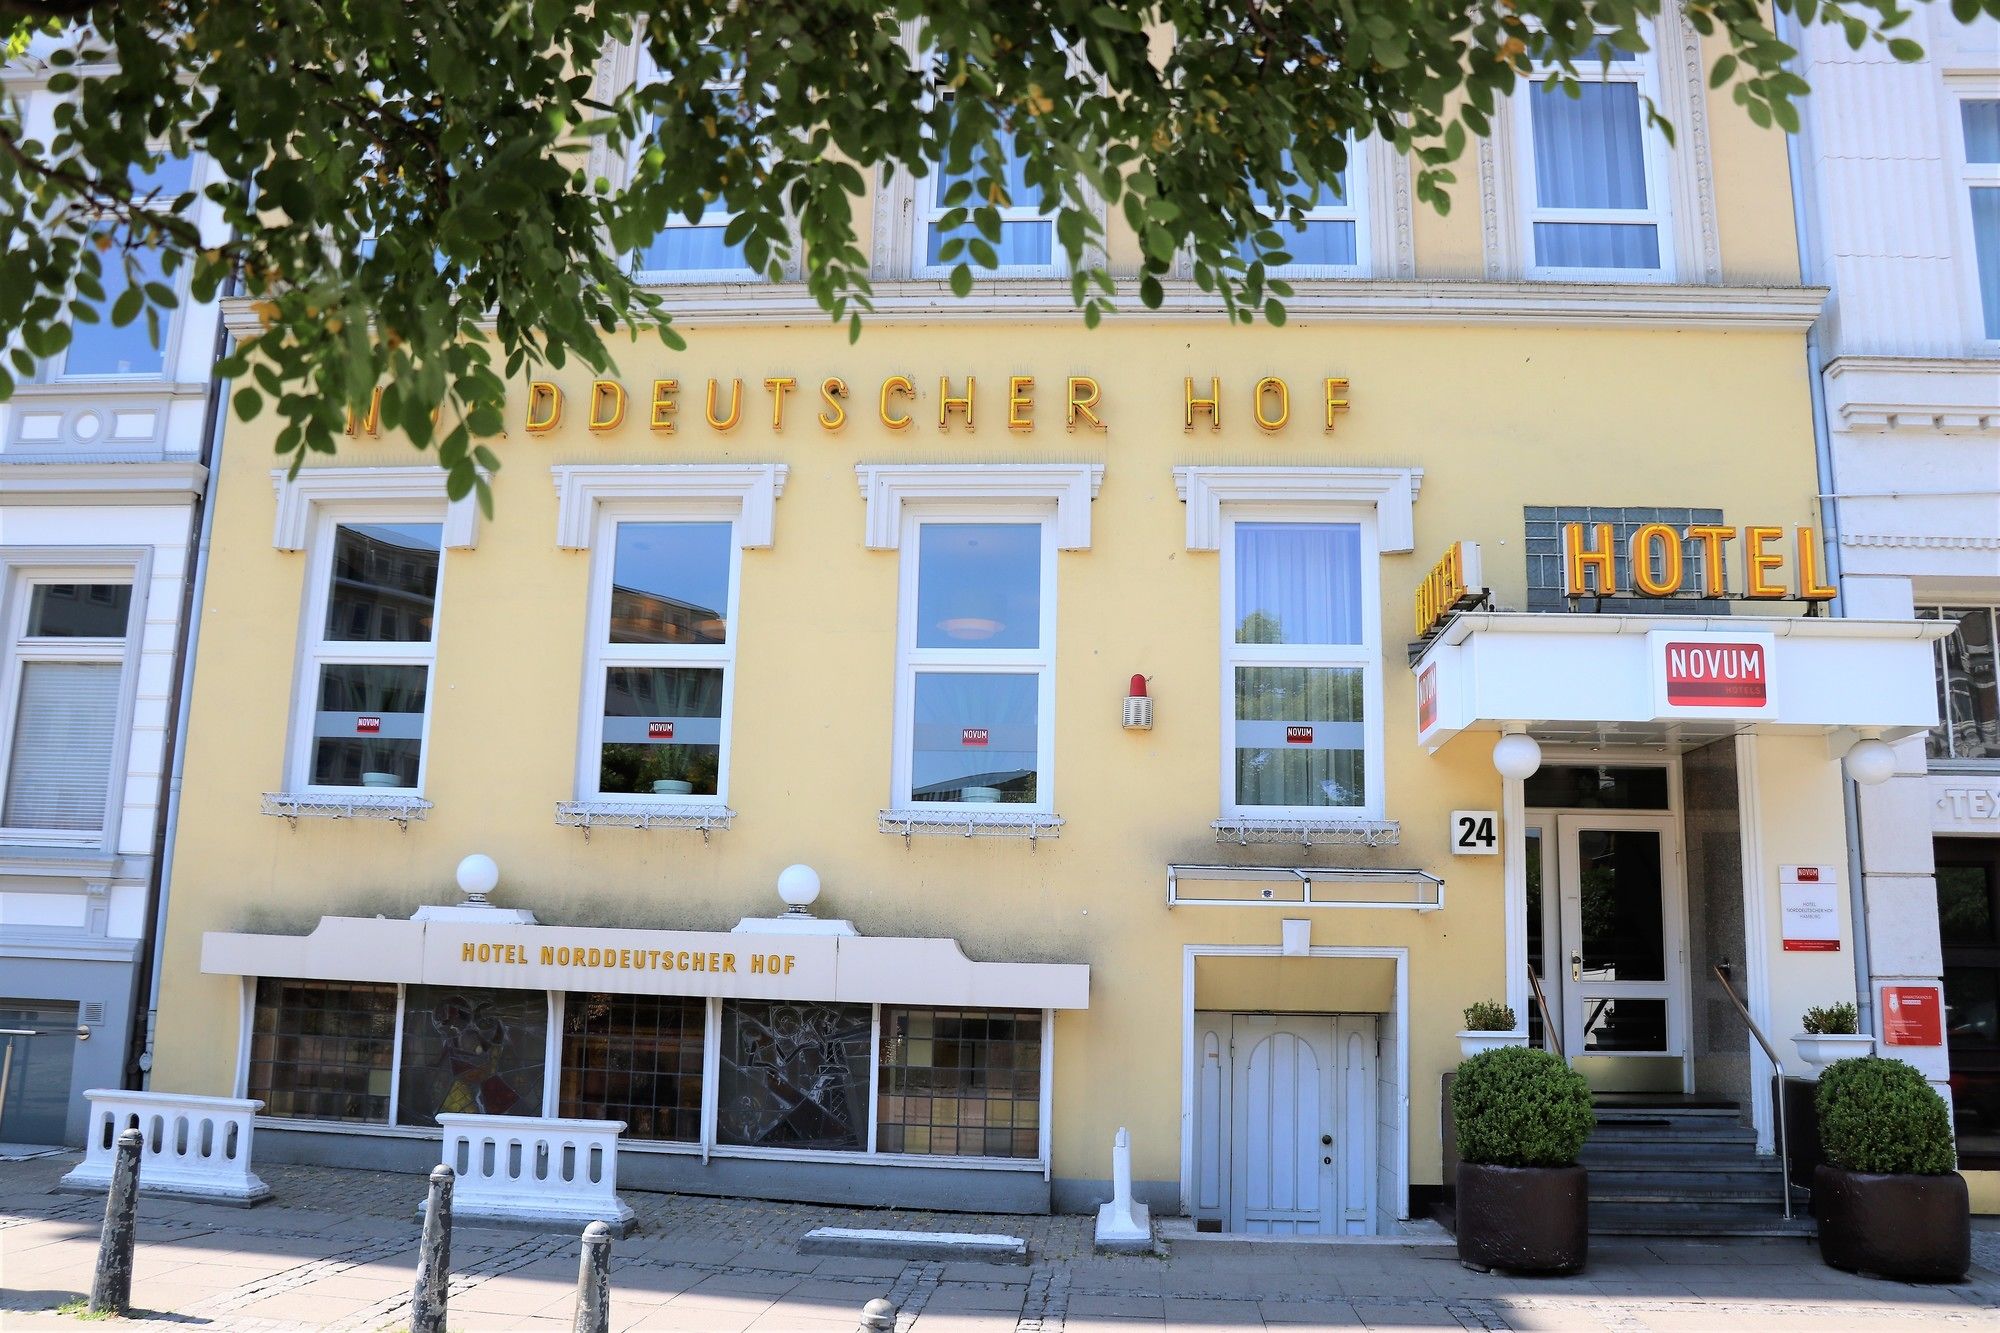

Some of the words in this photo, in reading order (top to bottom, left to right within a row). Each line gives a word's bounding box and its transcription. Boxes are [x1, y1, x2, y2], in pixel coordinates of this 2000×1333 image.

[346, 375, 1107, 435] NDDEUTSCHER
[1184, 376, 1350, 433] HOF
[1562, 522, 1838, 600] HOTEL
[1671, 648, 1760, 679] NOVUM
[358, 718, 380, 726] NOVUM
[650, 723, 673, 732] NOVUM
[963, 730, 988, 739] NOVUM
[1288, 728, 1312, 737] NOVUM
[1459, 817, 1496, 847] 24
[462, 942, 529, 965] HOTEL
[541, 945, 737, 973] NORDDEUTSCHER
[751, 953, 796, 975] HOF
